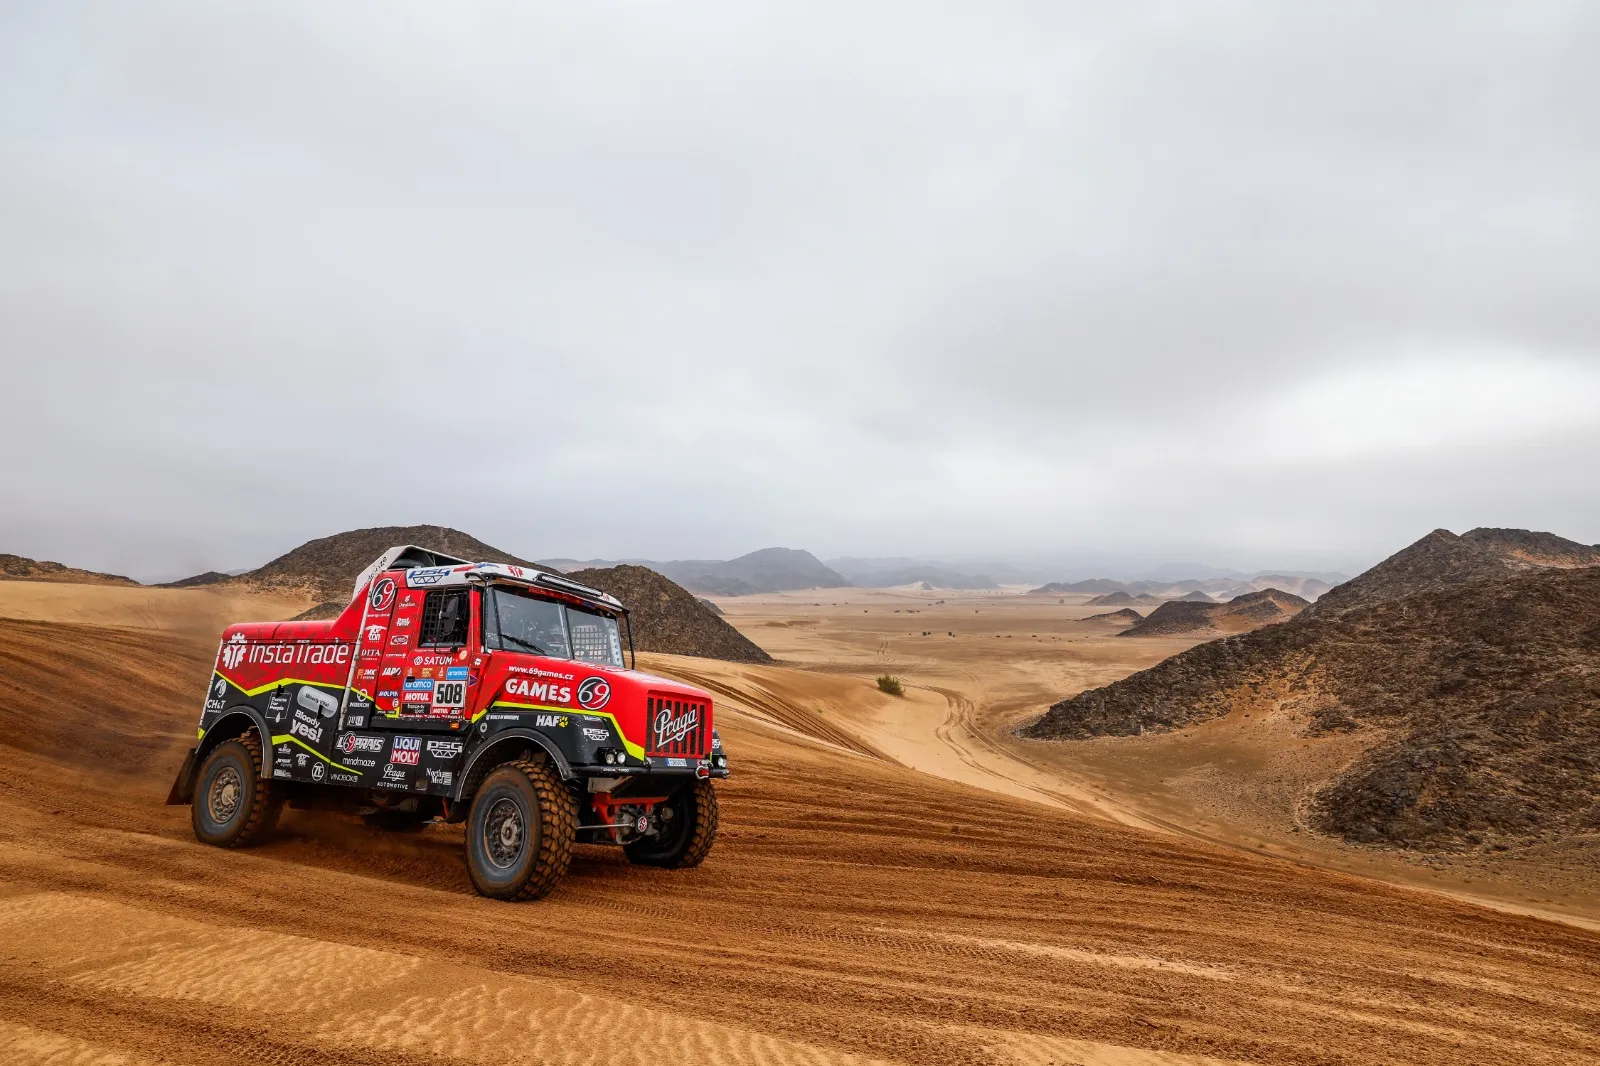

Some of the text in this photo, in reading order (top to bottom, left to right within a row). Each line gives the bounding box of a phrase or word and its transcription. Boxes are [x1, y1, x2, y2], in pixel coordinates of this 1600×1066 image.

[373, 581, 395, 609] 69
[423, 656, 453, 665] SATUM
[508, 665, 574, 680] www.69games.cz
[405, 680, 432, 688] aramco
[505, 678, 571, 703] GAMES
[404, 692, 429, 701] MOTUL
[436, 683, 463, 704] 508
[578, 679, 610, 706] 69
[206, 699, 226, 709] CH&T
[294, 709, 321, 729] Bloody
[536, 715, 559, 727] HAF
[290, 718, 324, 743] yes!
[653, 708, 699, 748] Praga
[394, 737, 420, 749] LIQUI
[427, 740, 464, 753] PSG
[342, 756, 376, 767] mindmaze
[392, 750, 418, 763] MOLY
[382, 763, 406, 781] Praga
[377, 781, 409, 790] AUTOMOTIVE
